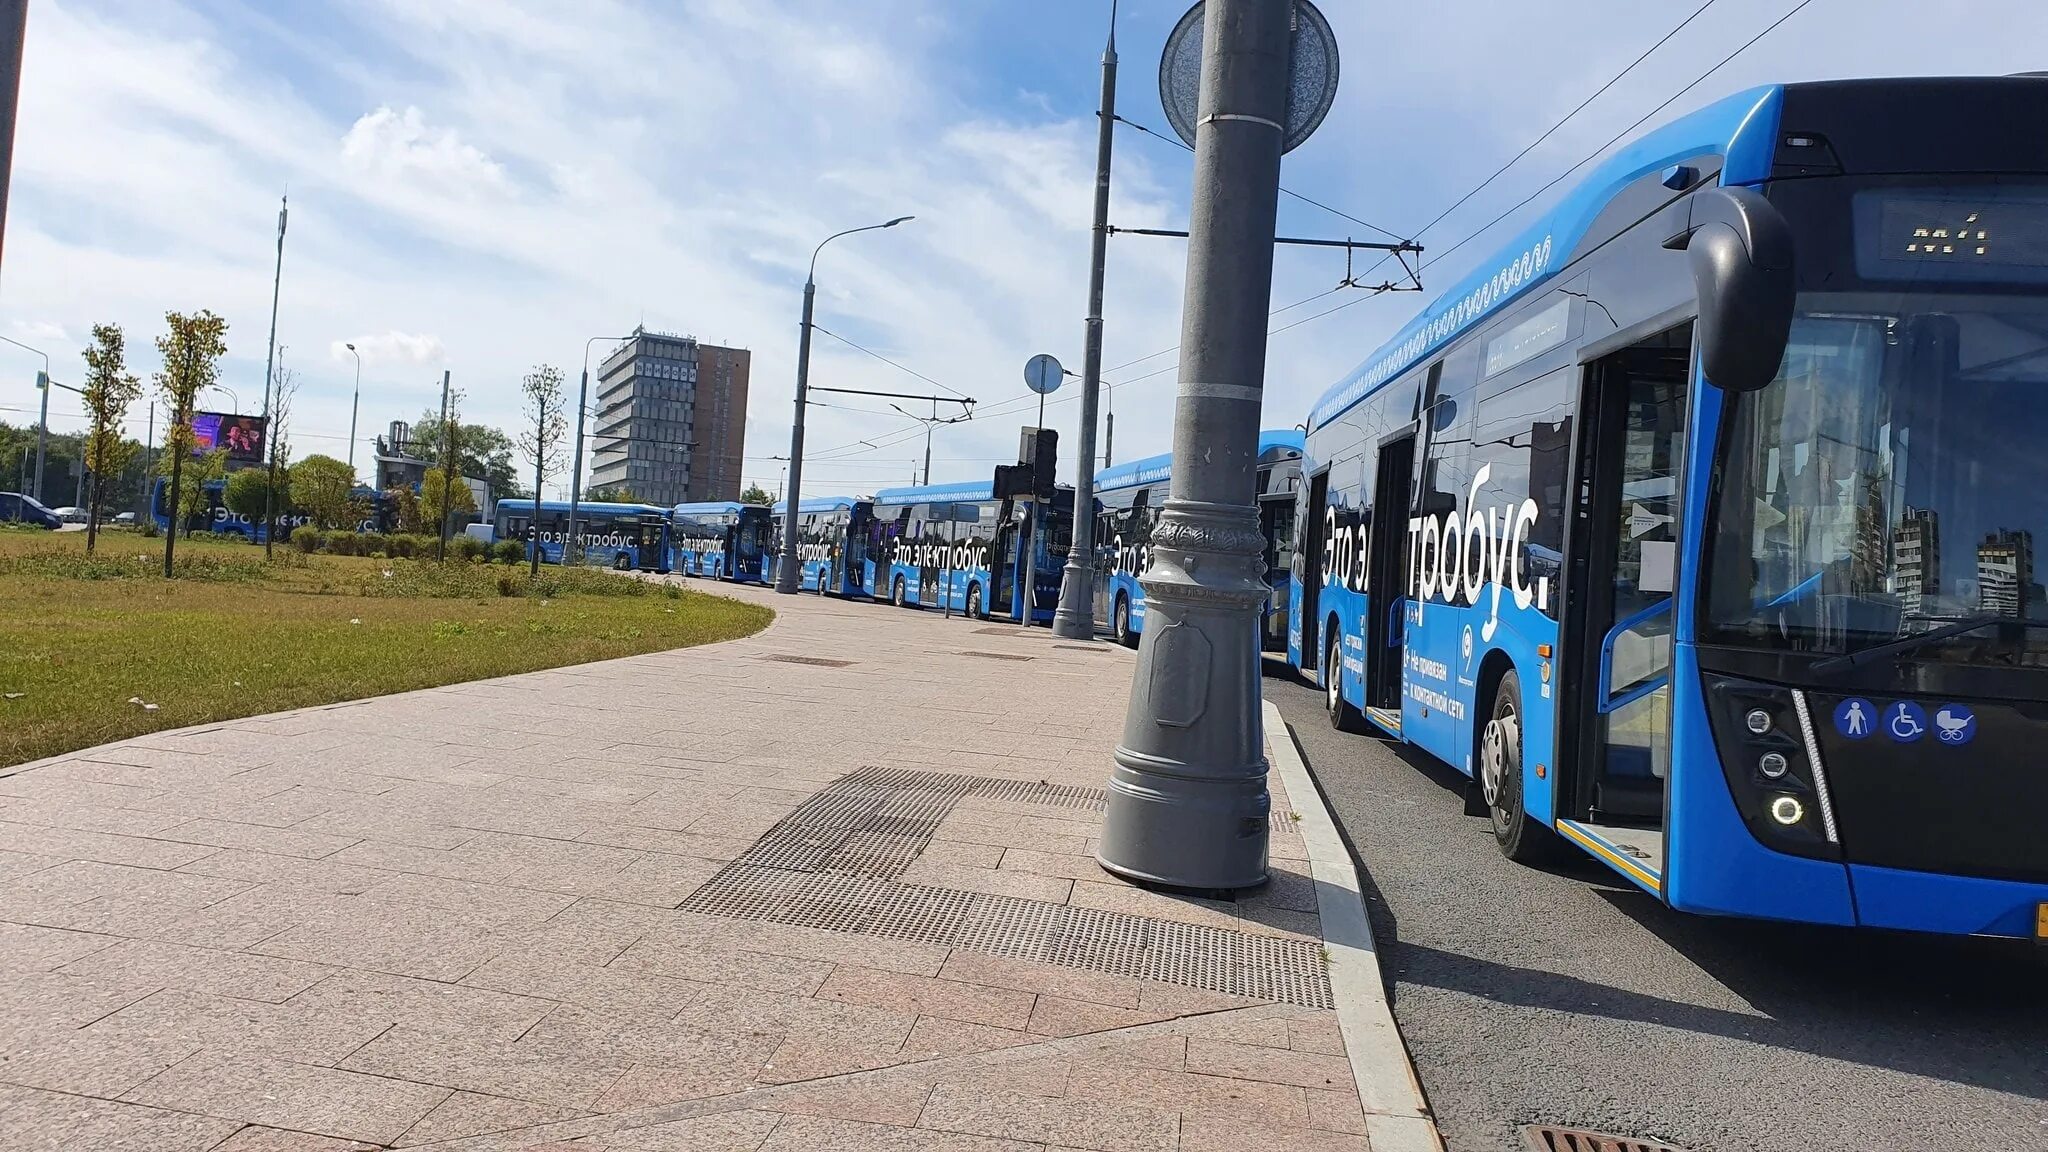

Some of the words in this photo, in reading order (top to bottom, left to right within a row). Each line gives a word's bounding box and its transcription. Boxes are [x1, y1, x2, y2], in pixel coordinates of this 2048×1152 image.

[214, 506, 251, 524] Это
[681, 533, 691, 552] Это
[891, 536, 911, 566] Это
[1111, 534, 1137, 577] Это
[1322, 506, 1351, 588] Это
